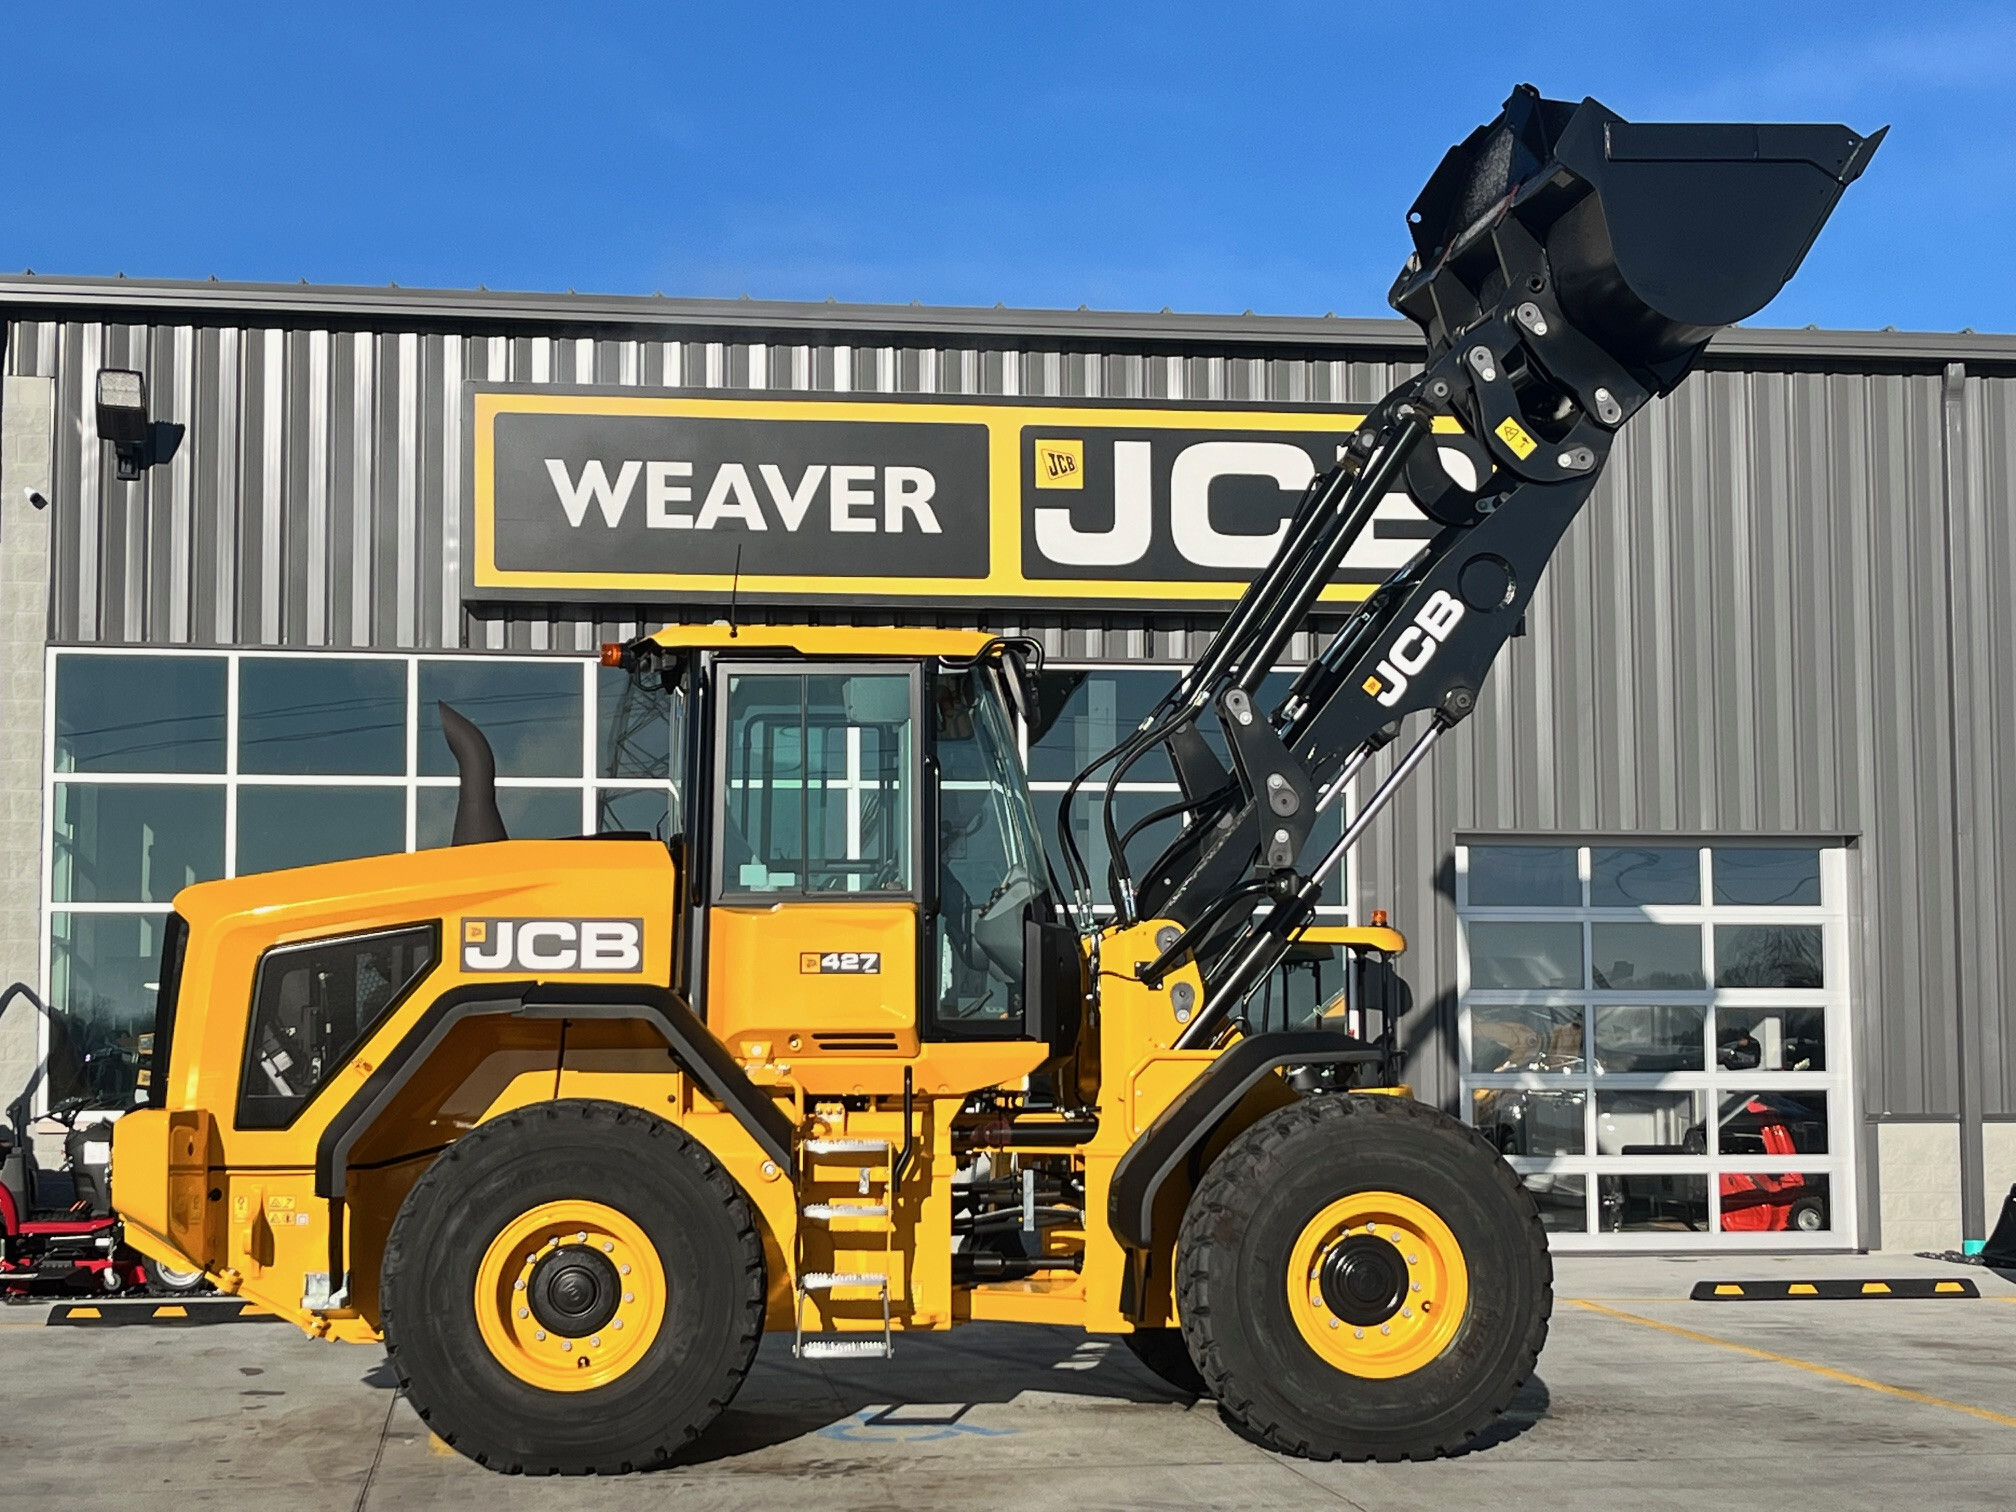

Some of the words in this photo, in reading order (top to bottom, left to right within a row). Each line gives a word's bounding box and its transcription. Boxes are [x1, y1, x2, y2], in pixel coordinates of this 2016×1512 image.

[1047, 452, 1076, 476] JCB
[543, 458, 943, 534] WEAVER
[1375, 589, 1466, 707] JCB
[464, 921, 640, 970] JCB
[821, 953, 878, 974] 427
